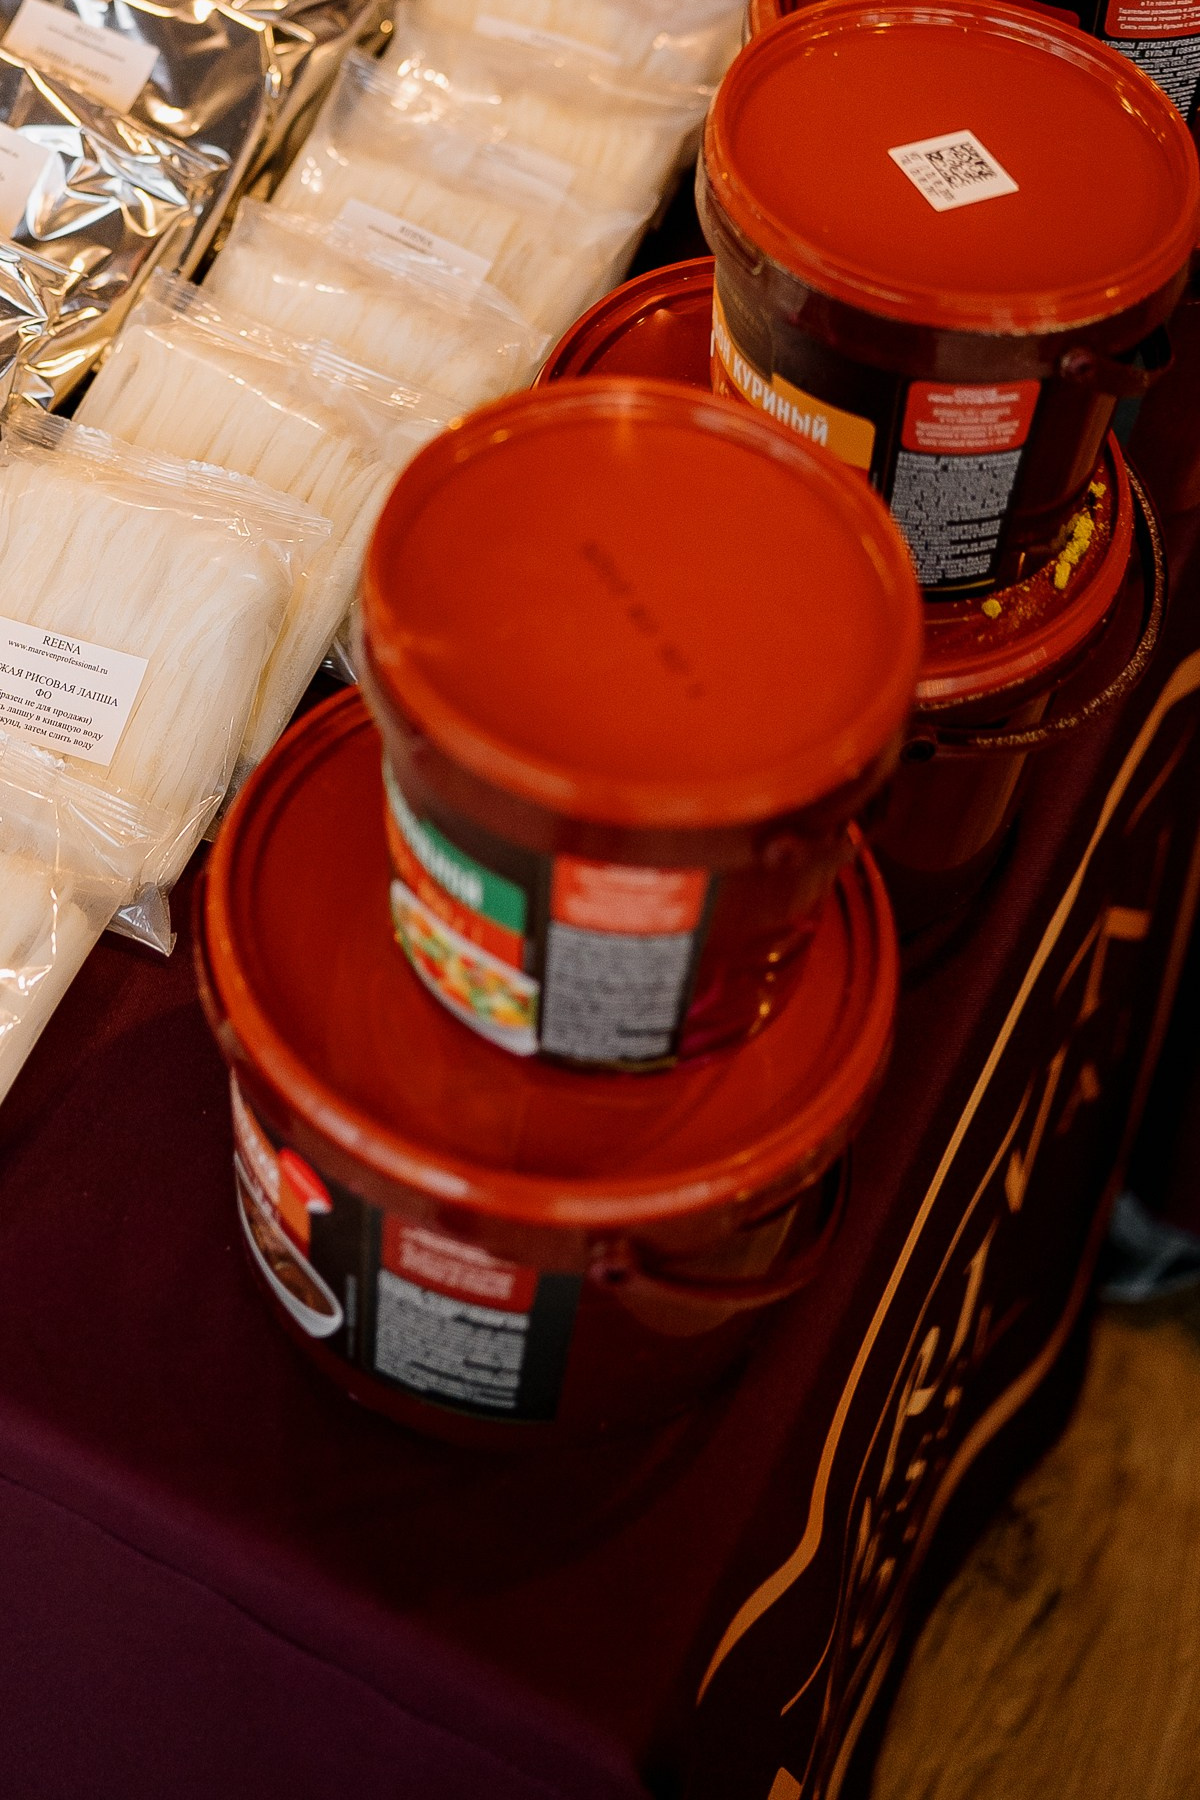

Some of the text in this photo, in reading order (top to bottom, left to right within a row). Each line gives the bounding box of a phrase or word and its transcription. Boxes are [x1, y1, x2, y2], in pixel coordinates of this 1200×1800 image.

[732, 354, 829, 448] КУРИНЫЙ
[8, 639, 108, 675] www.marevenprofessional.ru
[42, 635, 81, 655] REENA
[25, 671, 76, 694] РИСОВАЯ
[77, 687, 118, 707] ЛАПША
[35, 688, 52, 699] ФО
[6, 706, 35, 721] лапшу
[42, 717, 81, 734] кипящую
[83, 729, 103, 742] воду
[36, 703, 51, 713] для
[52, 708, 93, 726] продажи)
[24, 724, 47, 736] затем
[48, 731, 72, 743] слить
[73, 739, 94, 751] воду
